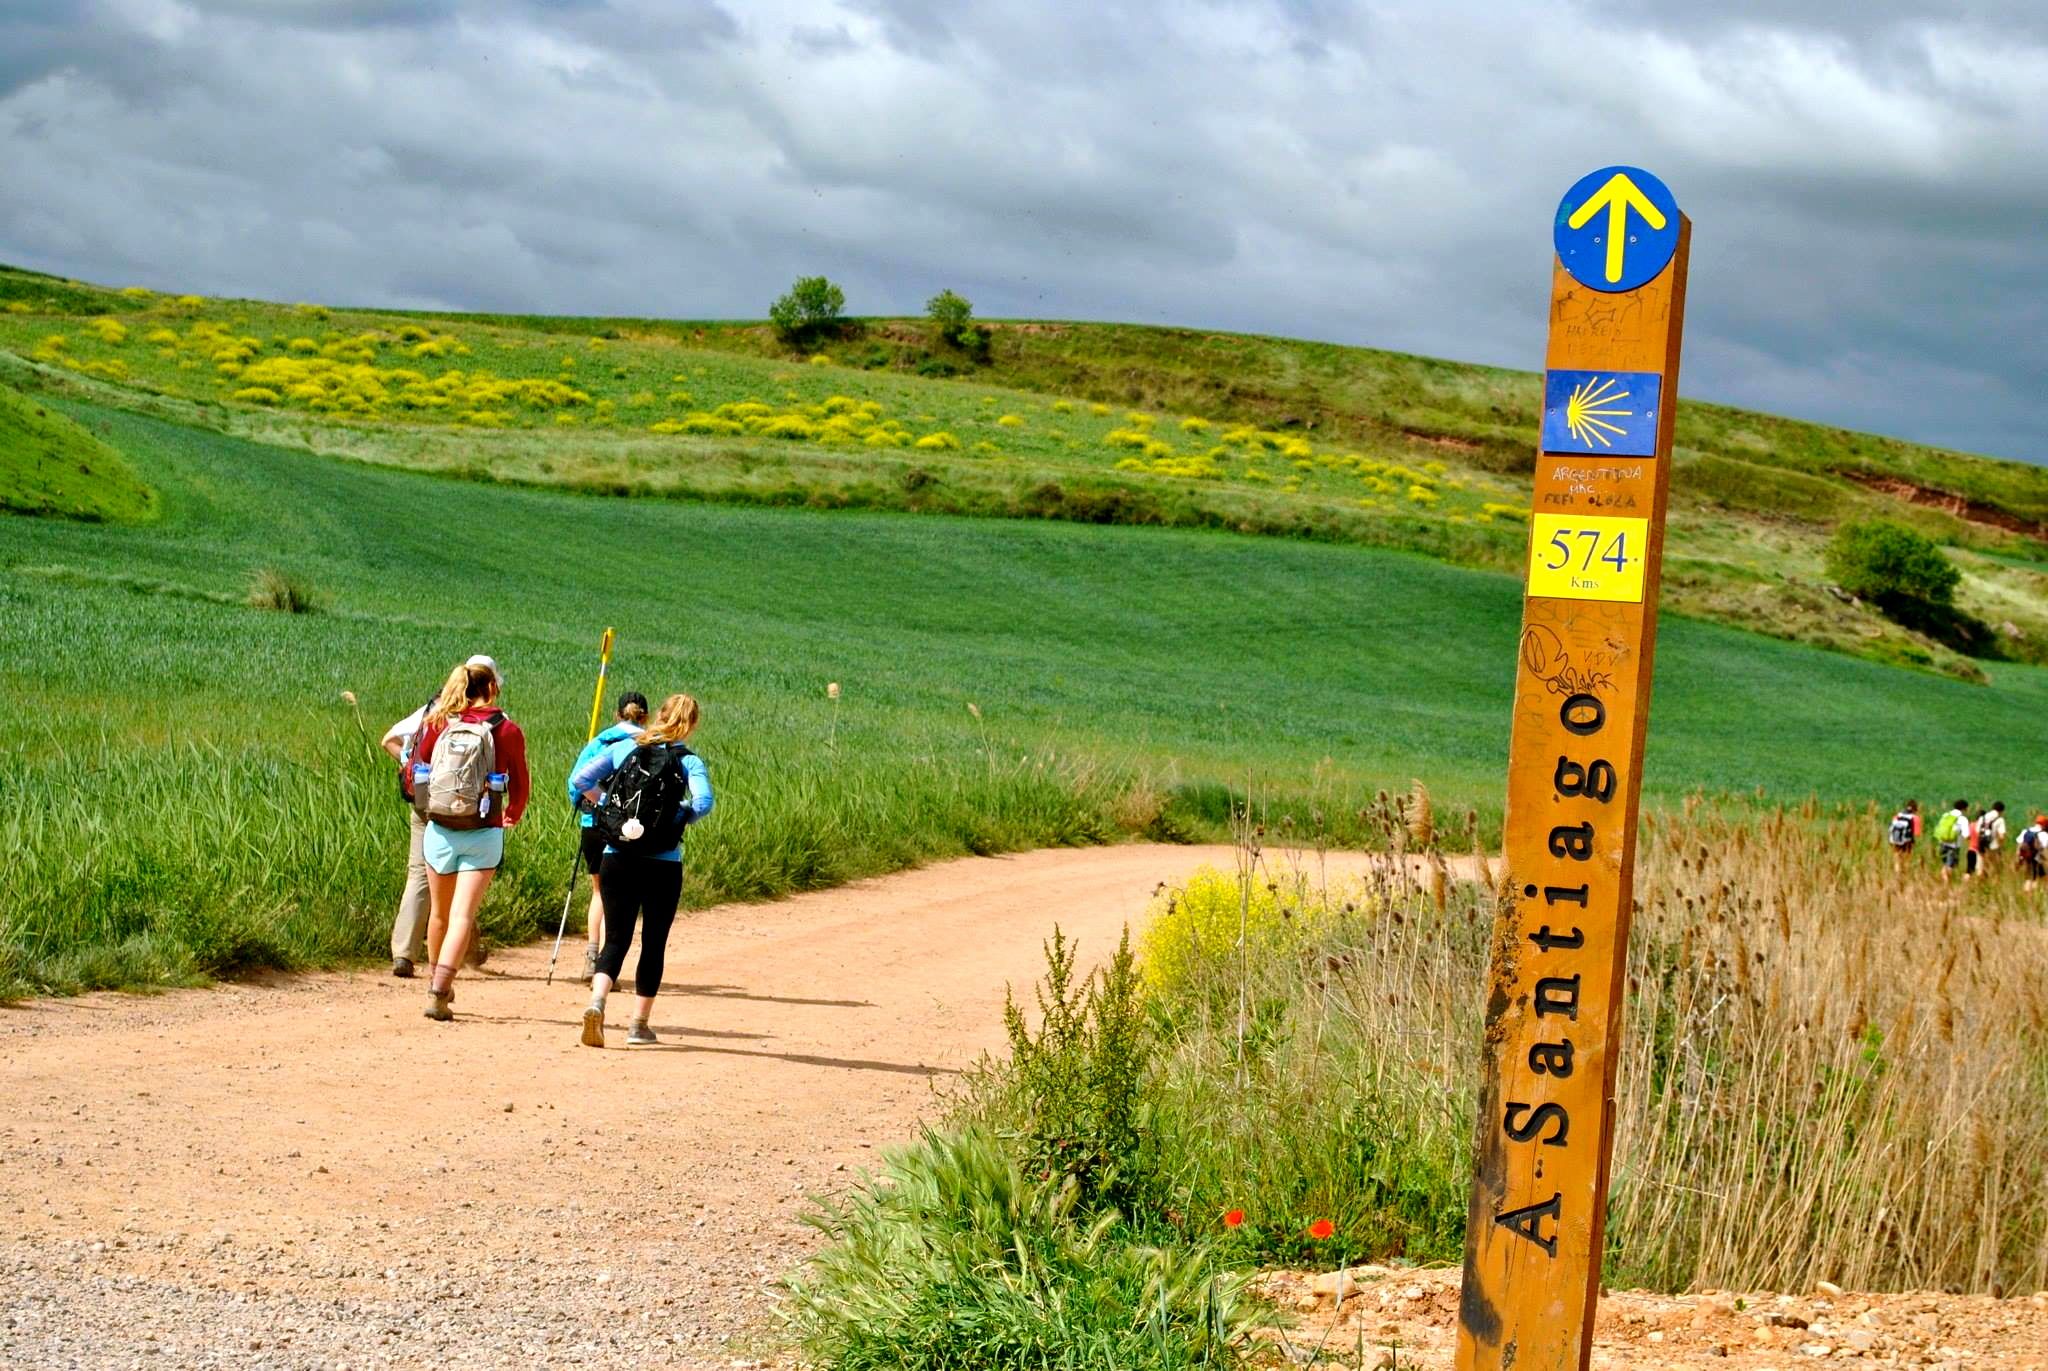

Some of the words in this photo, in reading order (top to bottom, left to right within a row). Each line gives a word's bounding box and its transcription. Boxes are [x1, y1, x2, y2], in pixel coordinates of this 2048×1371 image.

[1546, 529, 1628, 573] 574
[1571, 576, 1600, 589] Kms
[1503, 693, 1618, 1147] Santiago
[1494, 1192, 1562, 1259] A
